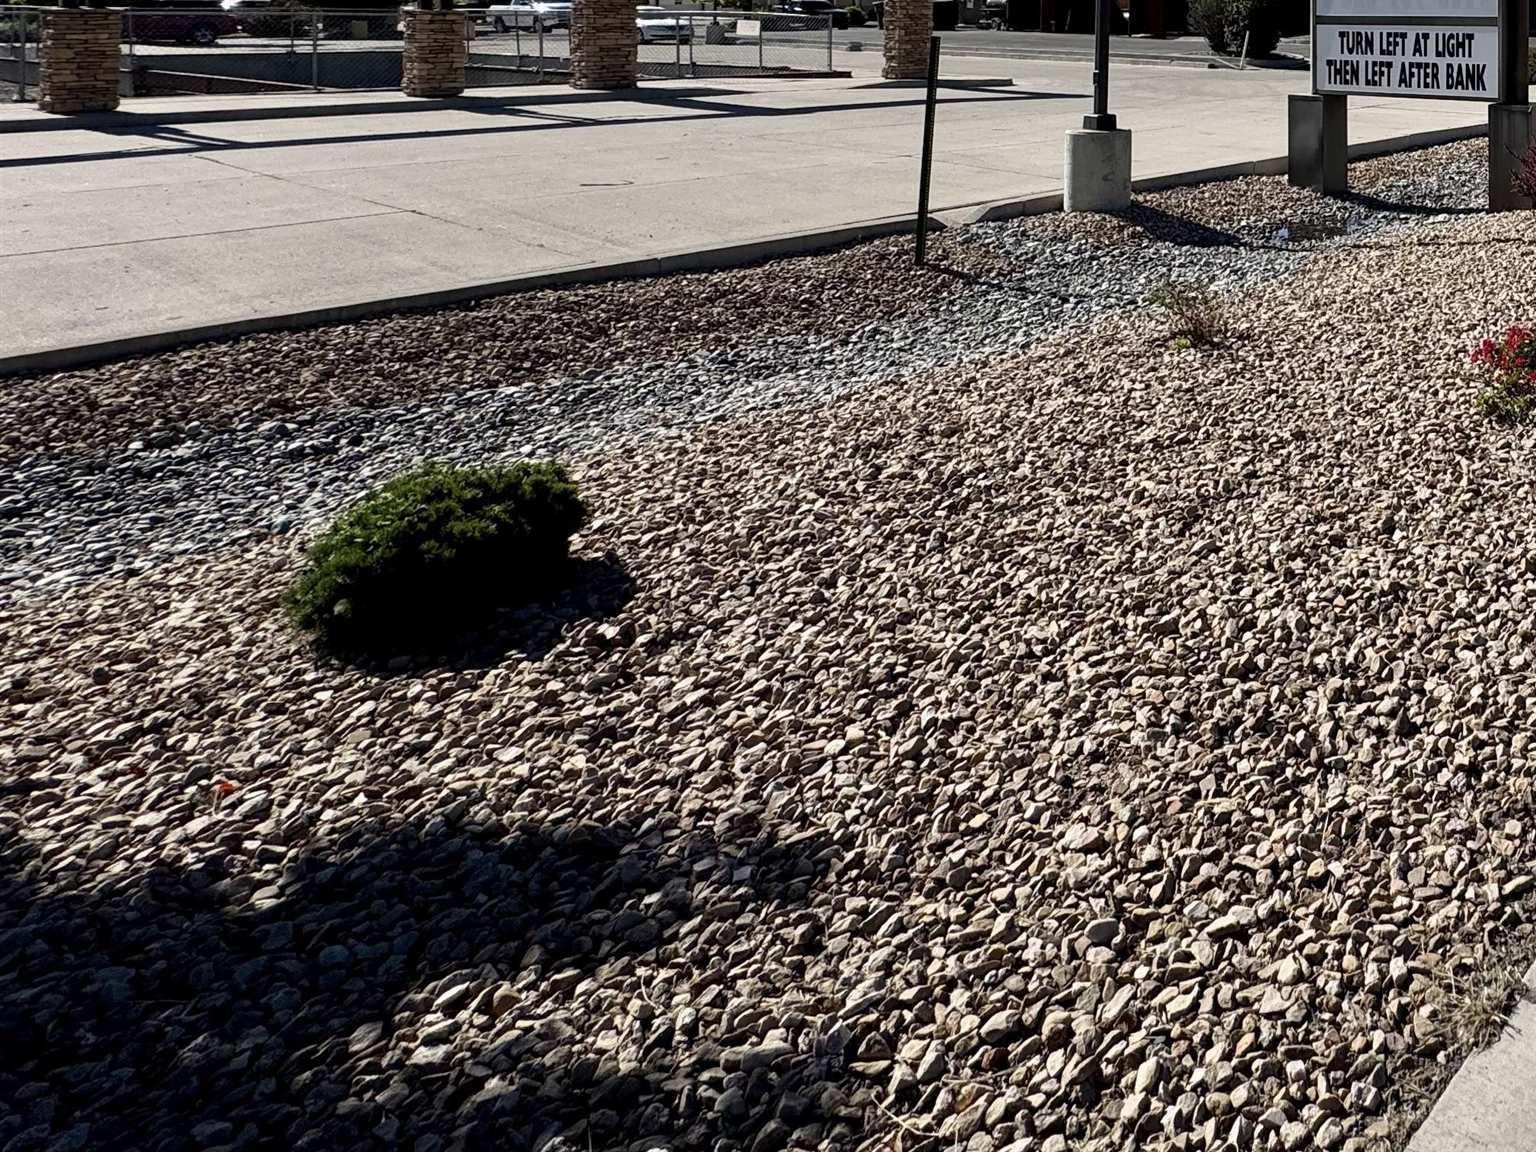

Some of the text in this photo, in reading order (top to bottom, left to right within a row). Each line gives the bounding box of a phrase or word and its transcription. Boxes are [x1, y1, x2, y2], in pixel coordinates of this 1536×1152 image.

[1338, 31, 1475, 58] TURN LEFT AT LIGHT
[1326, 59, 1487, 91] THEN LEFT AFTER BANK
